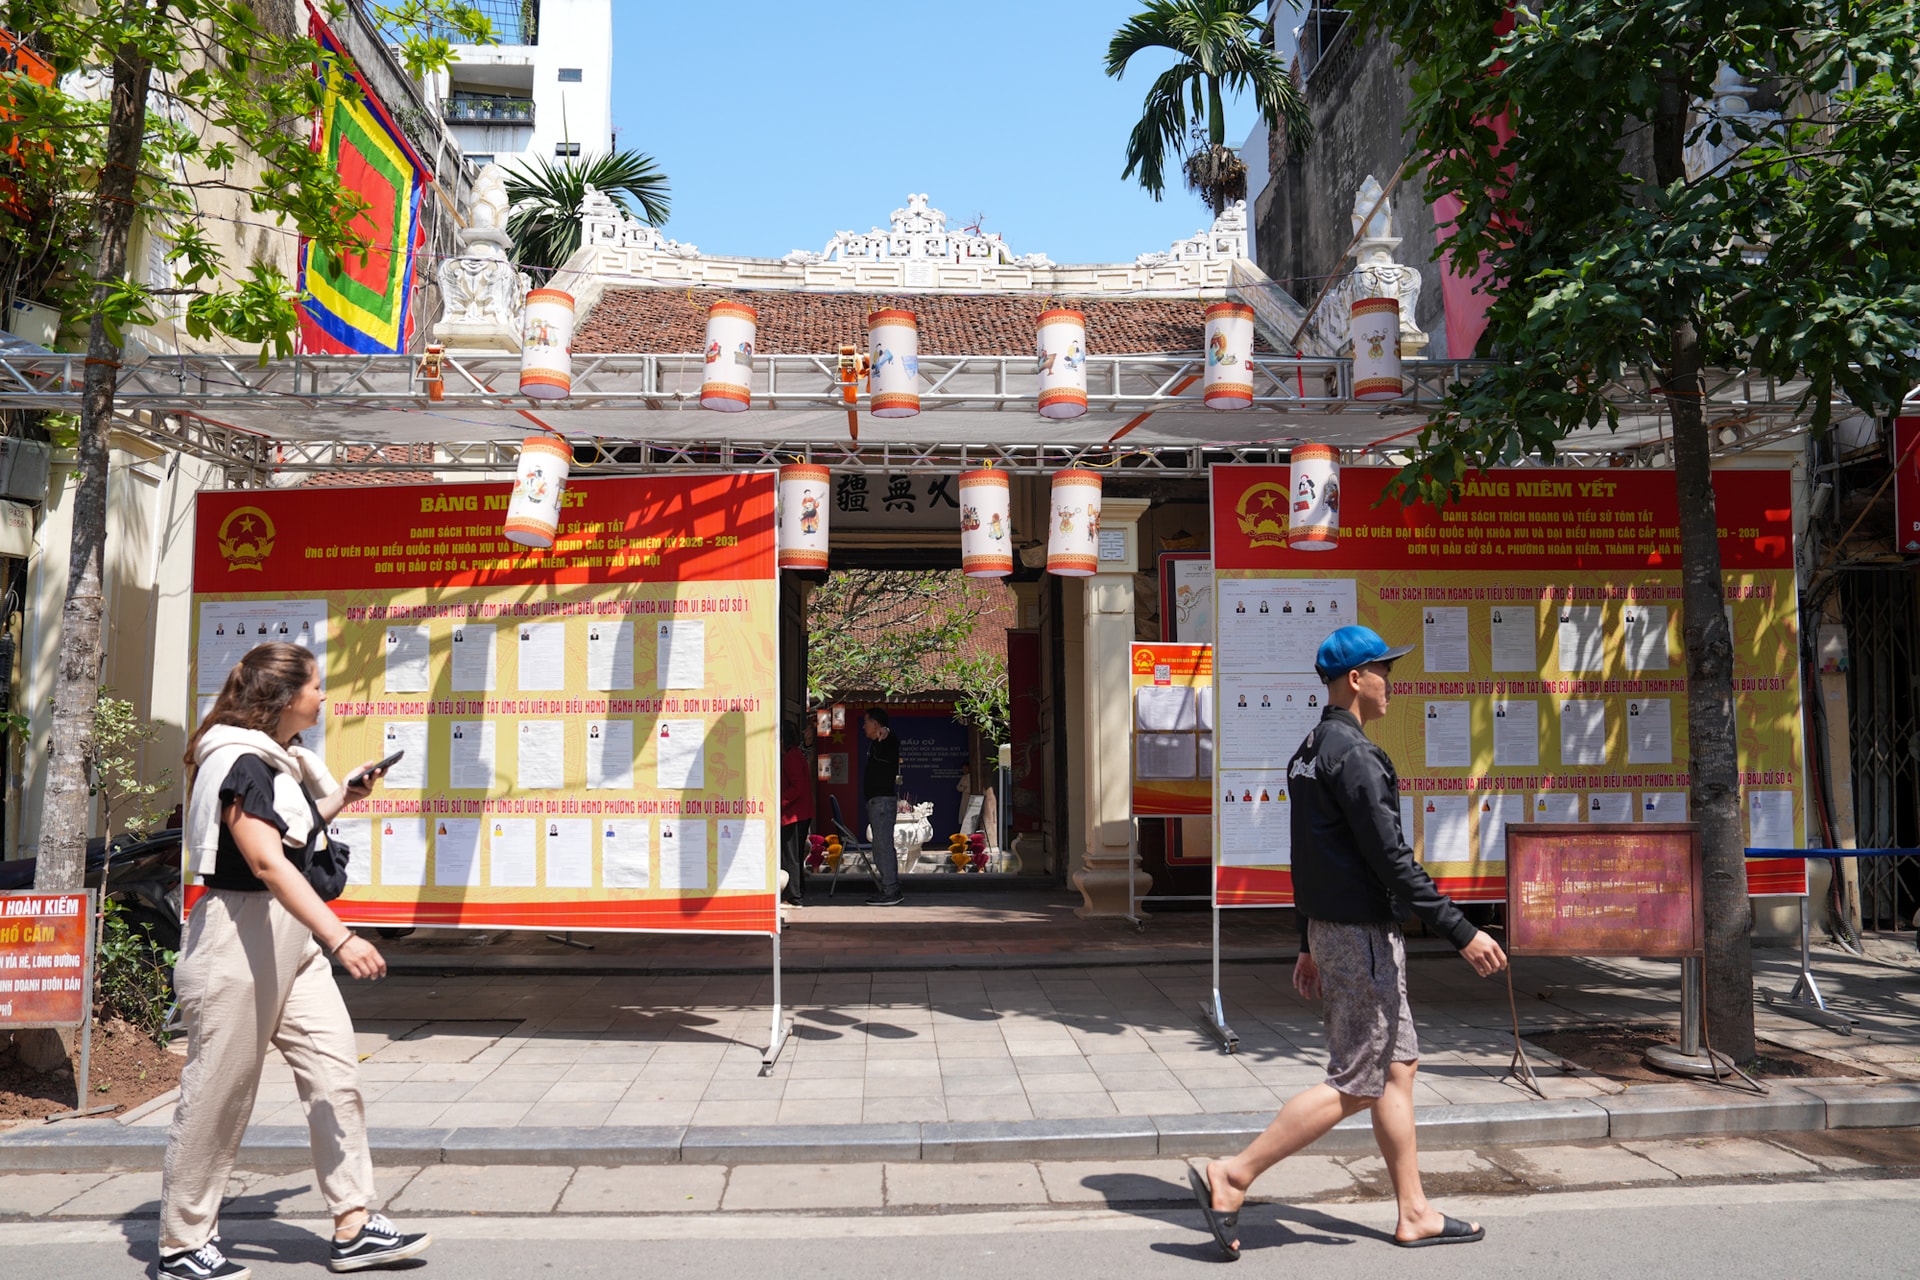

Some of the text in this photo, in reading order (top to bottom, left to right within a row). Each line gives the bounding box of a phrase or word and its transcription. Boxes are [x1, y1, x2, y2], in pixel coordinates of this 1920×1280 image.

[1578, 477, 1618, 498] YẾT
[420, 488, 588, 512] BẢNG NI ẾT
[1442, 507, 1654, 522] DANH SÁCH TRÍCH NGANG VÀ TIỂU SỬ TÓM TẮT
[410, 528, 435, 538] DANH
[437, 524, 462, 538] SÁCH
[465, 523, 492, 537] TRÍCH
[567, 520, 581, 535] SỬ
[583, 520, 605, 534] TÓM
[608, 518, 624, 534] TẮT
[1340, 528, 1352, 538] NG
[1354, 525, 1368, 538] CỬ
[1370, 525, 1392, 538] VIÊN
[1395, 528, 1412, 540] ĐẠI
[1414, 524, 1436, 538] BIỂU
[1438, 524, 1464, 538] QUỐC
[1466, 525, 1484, 540] HỘI
[1486, 525, 1511, 538] KHÓA
[1513, 528, 1529, 538] XVI
[1531, 525, 1544, 538] VÀ
[1546, 528, 1563, 540] ĐẠI
[1565, 524, 1587, 538] BIỂU
[1617, 525, 1636, 538] CÁC
[1638, 524, 1656, 538] CẤP
[1658, 525, 1680, 540] NHIỆ
[1716, 528, 1728, 538] 26
[1738, 528, 1760, 538] 2031
[305, 544, 324, 558] ỨNG
[325, 544, 338, 558] CỬ
[340, 543, 361, 557] VIÊN
[363, 546, 380, 558] ĐẠI
[381, 541, 403, 556] BIỂU
[405, 540, 430, 555] QUỐC
[432, 541, 449, 557] HỘI
[451, 540, 477, 554] KHÓA
[479, 543, 495, 553] XVI
[497, 540, 510, 553] VÀ
[585, 537, 604, 551] CÁC
[607, 535, 626, 550] CẤP
[628, 536, 662, 552] NHIỆM
[664, 535, 677, 548] KỲ
[678, 537, 704, 548] 2026
[715, 536, 738, 547] 2031
[1408, 544, 1428, 554] ĐƠN
[1430, 544, 1440, 556] VỊ
[1442, 540, 1462, 554] BẦU
[1464, 542, 1478, 554] CỬ
[1479, 540, 1493, 554] SỐ
[1506, 542, 1545, 554] PHƯỜNG
[1547, 542, 1573, 554] HOÀN
[1605, 542, 1635, 554] THÀNH
[1637, 540, 1656, 554] PHỐ
[1658, 542, 1670, 554] HÀ
[374, 563, 394, 573] ĐƠN
[396, 563, 406, 574] VỊ
[408, 558, 427, 572] BẦU
[429, 560, 442, 572] CỬ
[444, 558, 458, 571] SỐ
[471, 558, 510, 571] PHƯỜNG
[512, 557, 538, 570] HOÀN
[571, 556, 602, 568] THÀNH
[605, 554, 625, 567] PHỐ
[627, 555, 641, 567] HÀ
[643, 554, 660, 568] NỘI
[1393, 679, 1413, 694] SÁCH
[1415, 679, 1437, 694] TRÍCH
[1439, 682, 1464, 694] NGANG
[1466, 678, 1476, 694] VÀ
[1478, 676, 1494, 694] TIỂU
[1496, 678, 1506, 693] SỬ
[1508, 678, 1525, 693] TÓM
[1527, 676, 1539, 693] TẮT
[1541, 678, 1556, 693] ỨNG
[1558, 677, 1569, 693] CỬ
[1570, 677, 1587, 692] VIÊN
[1589, 680, 1602, 695] ĐẠI
[1604, 675, 1621, 692] BIỂU
[1645, 676, 1668, 692] THÀNH
[1670, 674, 1685, 691] PHỐ
[334, 702, 353, 716] DANH
[355, 699, 375, 715] SÁCH
[377, 699, 398, 715] TRÍCH
[399, 702, 424, 715] NGANG
[426, 698, 436, 715] VÀ
[438, 696, 454, 715] TIỂU
[455, 698, 466, 715] SỬ
[468, 698, 484, 715] TÓM
[487, 696, 499, 714] TẮT
[501, 698, 517, 714] ỨNG
[518, 698, 529, 714] CỬ
[531, 698, 548, 714] VIÊN
[549, 701, 563, 717] ĐẠI
[565, 695, 583, 714] BIỂU
[608, 697, 633, 714] THÀNH
[635, 695, 651, 713] PHỐ
[652, 697, 663, 713] HÀ
[683, 700, 700, 713] ĐƠN
[701, 700, 710, 716] VỊ
[712, 694, 728, 713] BẦU
[730, 696, 741, 713] CỬ
[743, 694, 754, 713] SỐ
[756, 699, 760, 712] 1
[6, 896, 41, 915] HOÀN
[45, 896, 79, 914] KIẾM
[0, 922, 55, 943] HỐ CẤM
[19, 953, 30, 969] HÈ,
[32, 952, 52, 968] LÒNG
[54, 952, 80, 968] ĐƯỜNG
[0, 976, 80, 992] INH DOANH BUÔN BÁN
